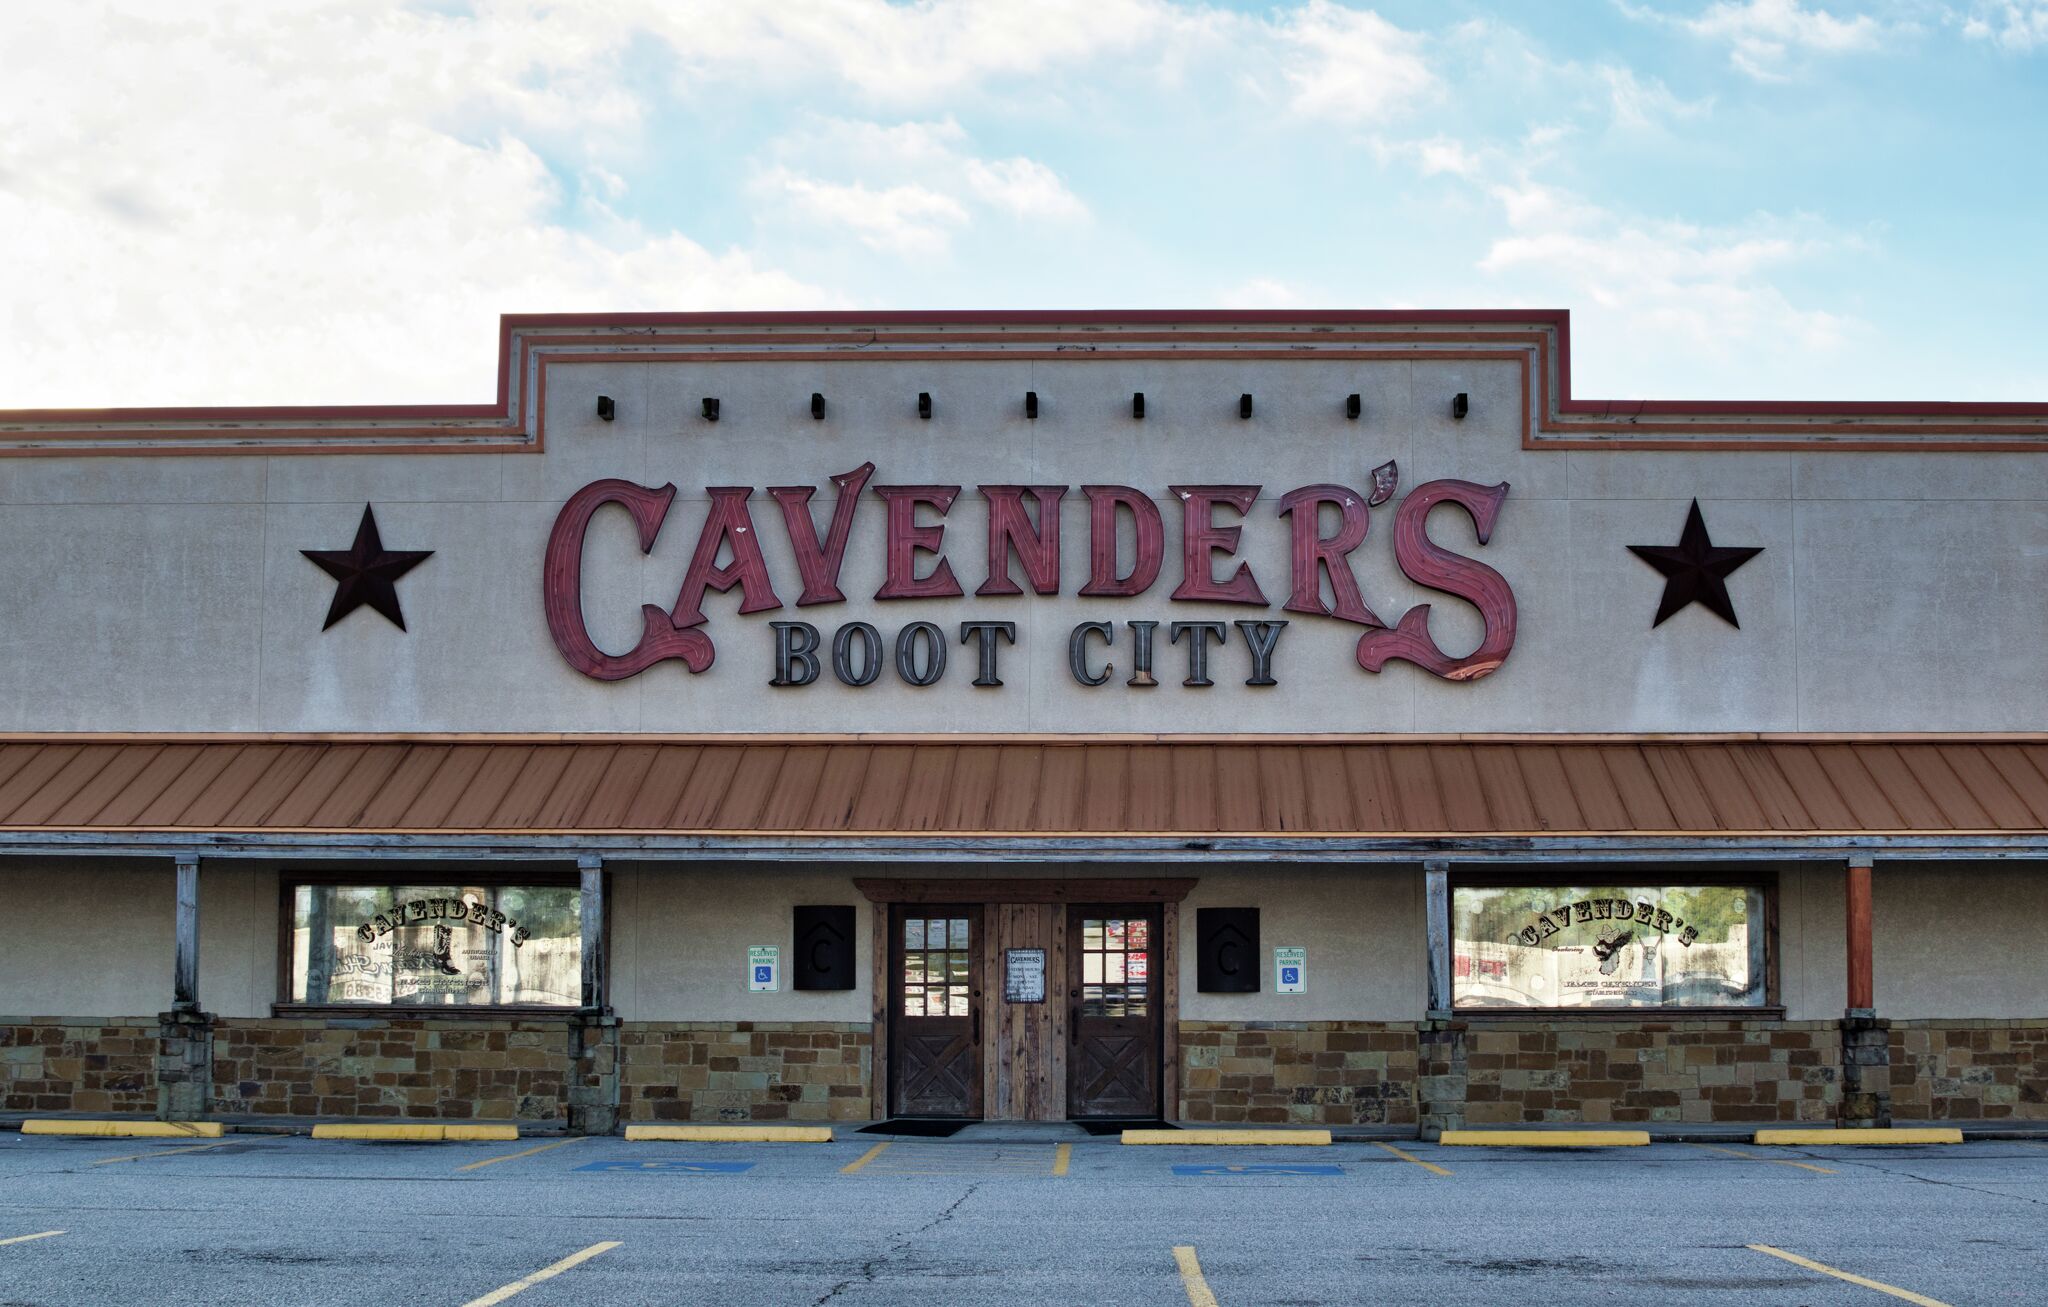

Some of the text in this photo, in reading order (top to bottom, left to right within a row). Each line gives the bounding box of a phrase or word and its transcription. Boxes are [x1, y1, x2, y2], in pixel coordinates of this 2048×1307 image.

[544, 460, 1517, 682] CAVENDER'S
[768, 620, 1290, 687] BOOT CITY
[357, 898, 531, 948] CAVENDER'S
[1520, 898, 1699, 948] CAVENDER'S
